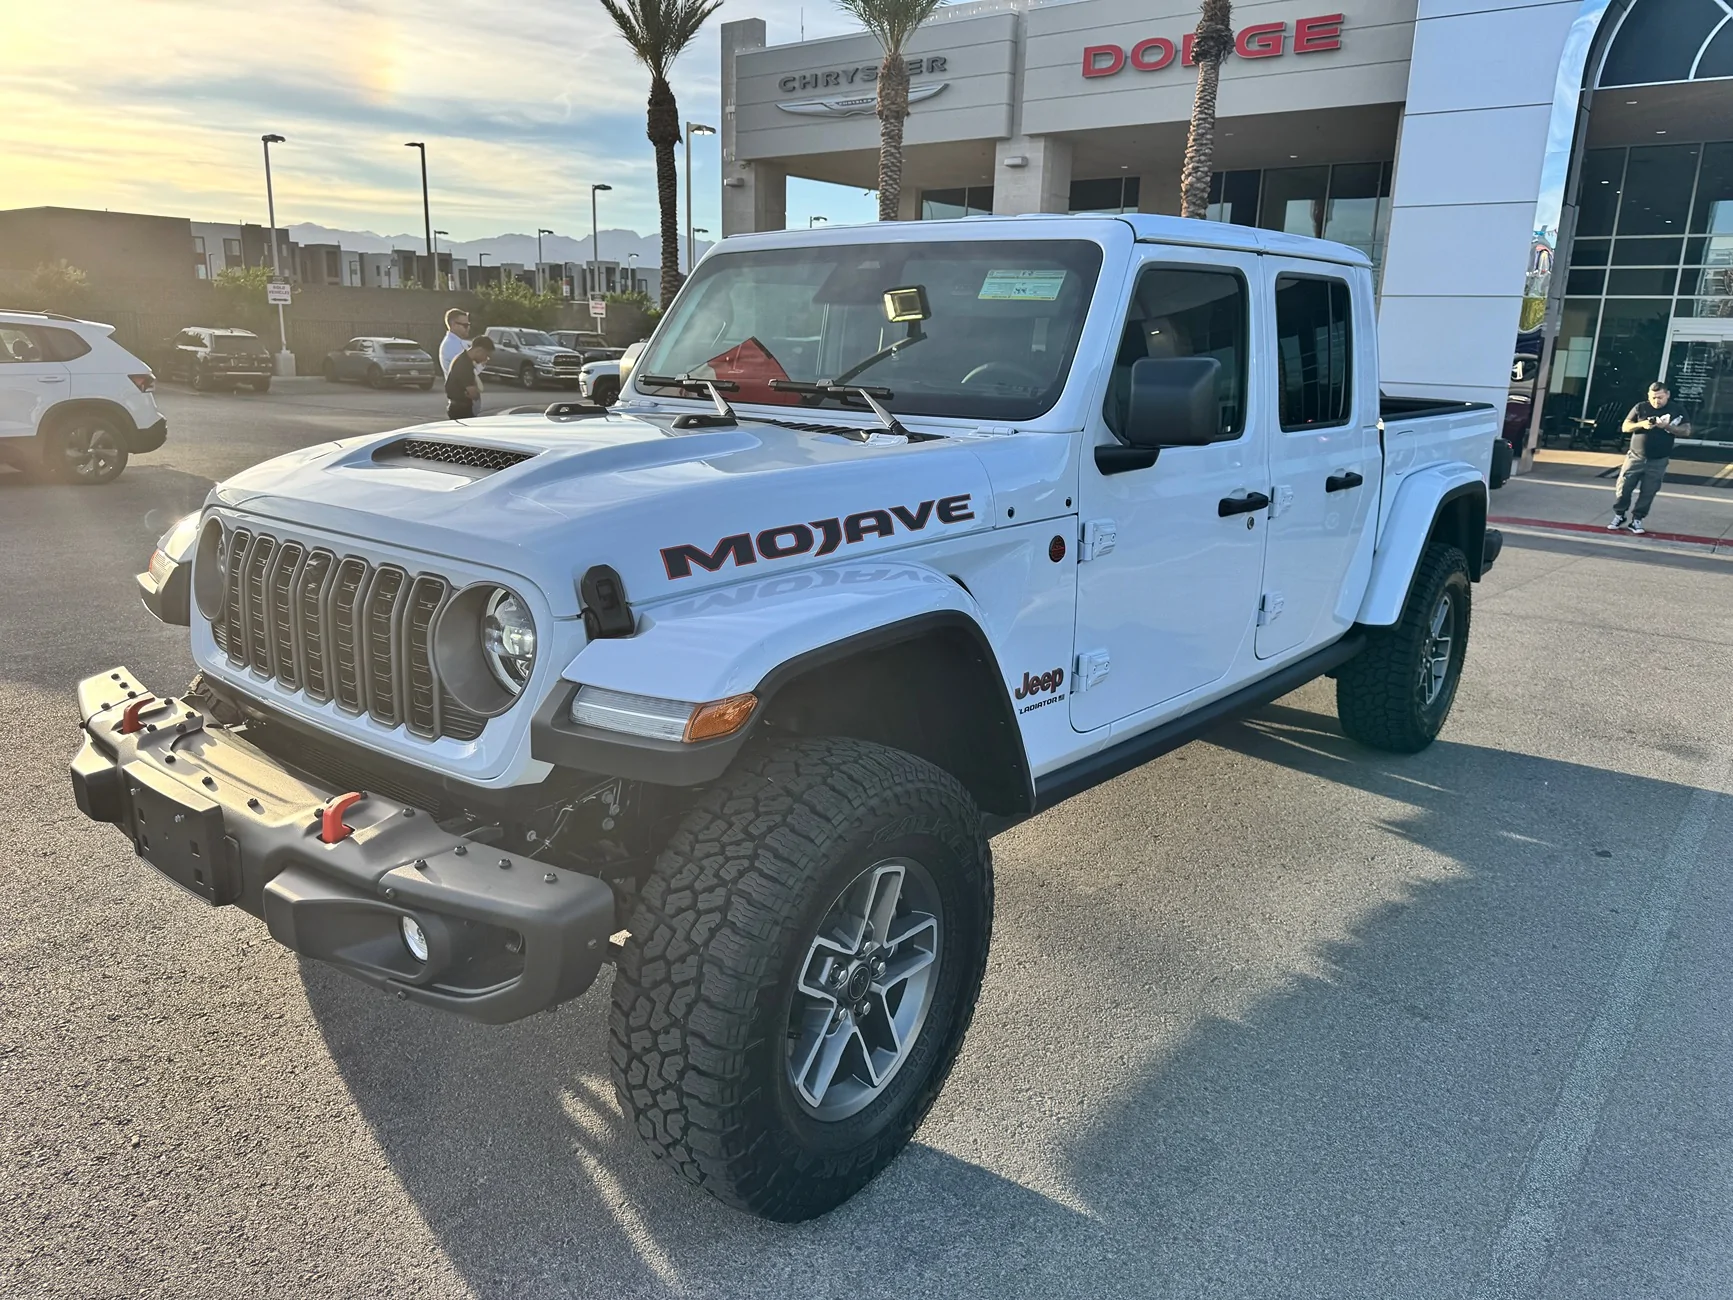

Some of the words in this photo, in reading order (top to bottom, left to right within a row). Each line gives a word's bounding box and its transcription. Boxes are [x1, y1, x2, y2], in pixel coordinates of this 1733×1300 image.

[778, 56, 948, 93] CHRYSER
[659, 493, 975, 580] MOJAVE
[1014, 667, 1064, 700] Jeep
[1018, 696, 1058, 715] LADIATOR
